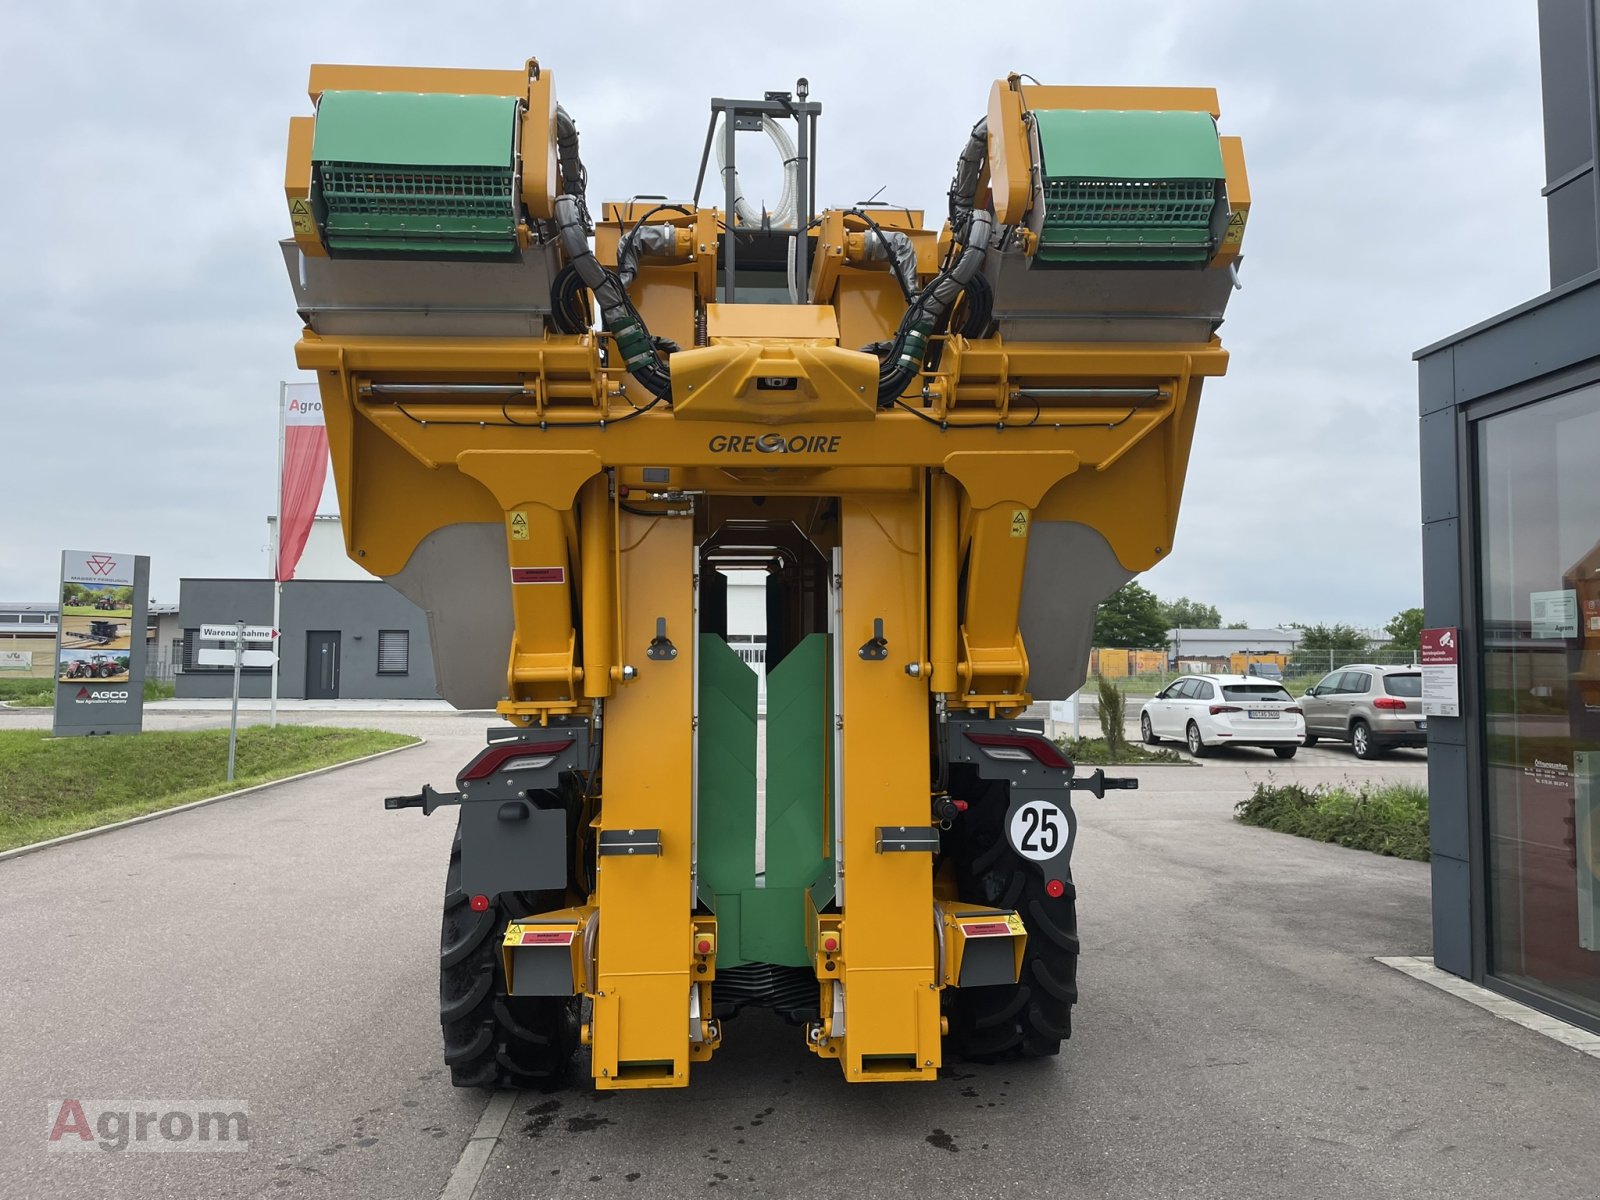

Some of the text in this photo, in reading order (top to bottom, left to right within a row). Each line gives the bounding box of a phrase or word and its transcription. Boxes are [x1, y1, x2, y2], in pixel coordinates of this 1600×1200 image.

[709, 433, 841, 453] GREGOIRE
[91, 691, 128, 699] AGCO
[1021, 807, 1059, 853] 25
